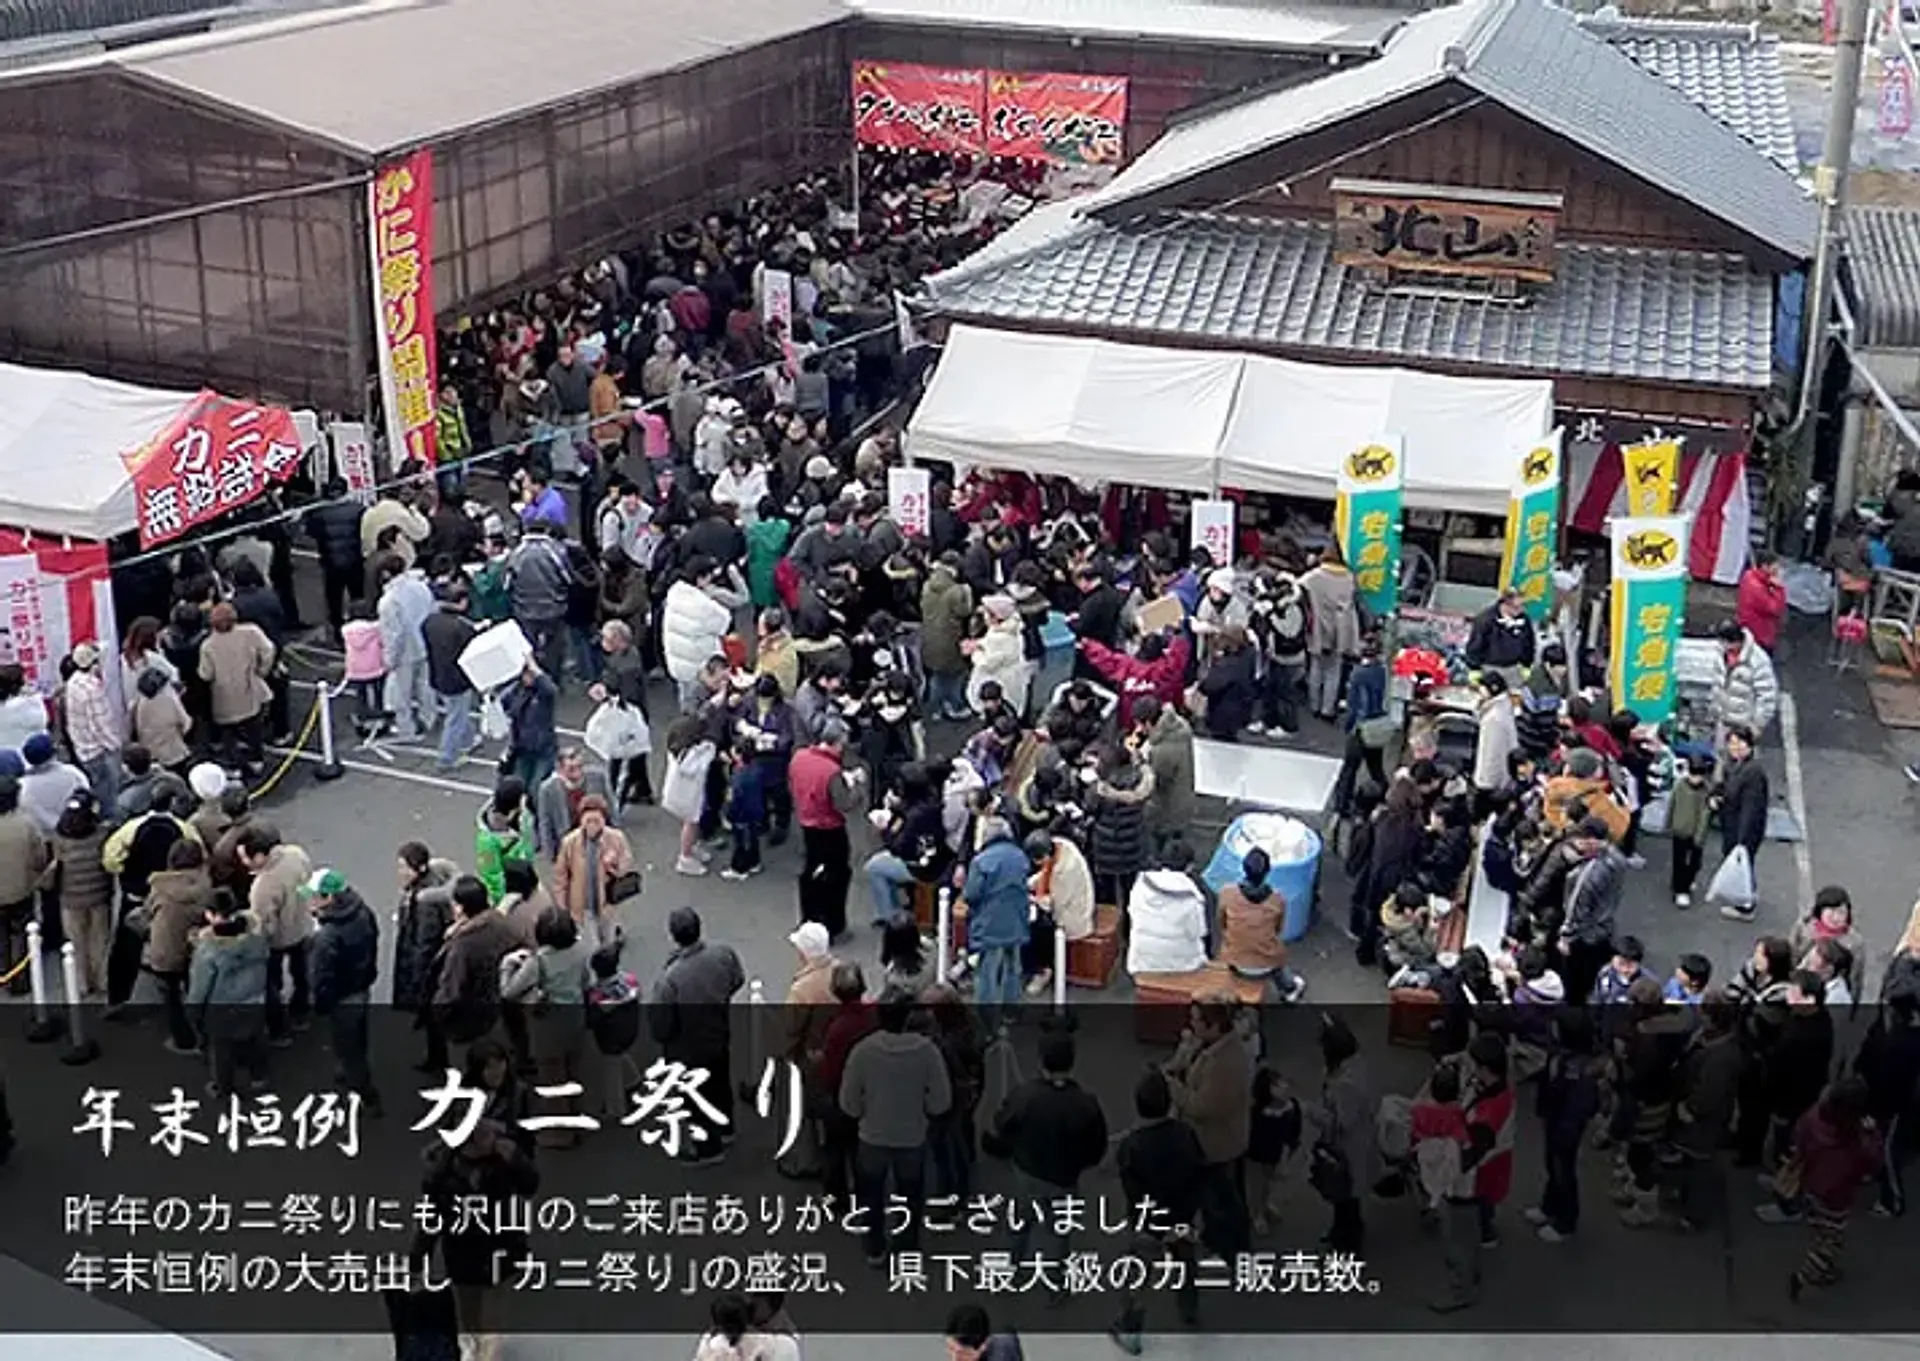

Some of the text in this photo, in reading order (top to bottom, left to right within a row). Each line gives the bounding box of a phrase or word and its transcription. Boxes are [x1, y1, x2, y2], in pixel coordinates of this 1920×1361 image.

[172, 409, 264, 474] カニ
[1633, 603, 1671, 700] 宅急便
